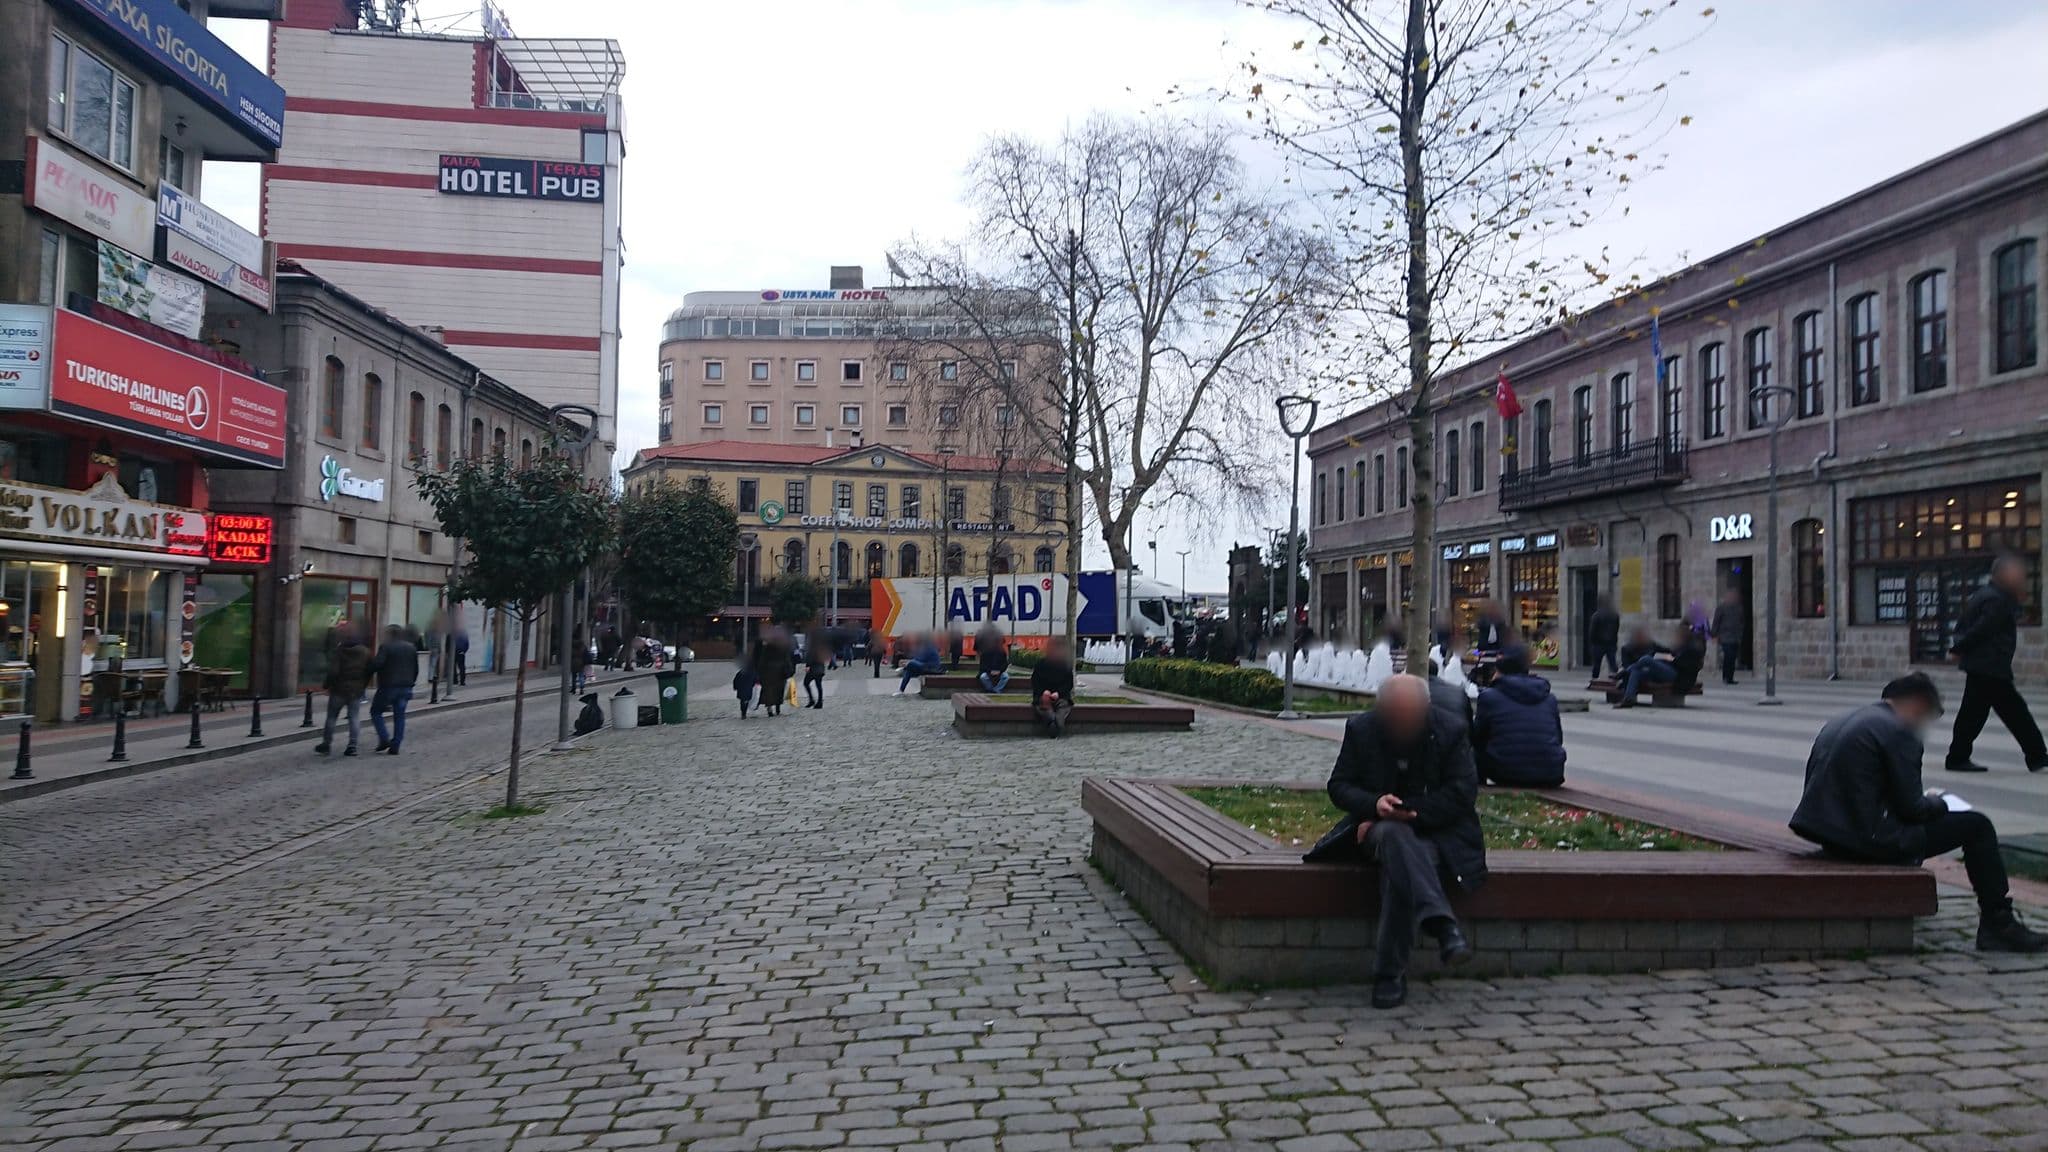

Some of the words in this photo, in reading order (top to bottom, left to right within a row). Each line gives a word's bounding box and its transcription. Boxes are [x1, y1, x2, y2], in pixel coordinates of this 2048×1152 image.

[107, 0, 150, 40] AXA
[155, 24, 229, 97] SİGORTA
[441, 156, 481, 168] KALFA
[543, 163, 601, 177] TERAS
[441, 168, 527, 195] HOTEL
[541, 176, 600, 198] PUB
[782, 291, 807, 299] USTA
[809, 291, 836, 299] PARK
[841, 291, 888, 301] HOTEL
[66, 359, 128, 395] TURKISH
[130, 381, 186, 411] AIRLINES
[40, 496, 159, 541] VOLKAN
[220, 518, 253, 529] 03:00
[256, 520, 265, 530] E
[848, 517, 882, 527] SHOP
[957, 523, 1010, 531] RESTAURNT
[1711, 513, 1752, 542] D&R
[217, 531, 266, 544] KADAR
[222, 546, 262, 560] AÇIK
[948, 585, 1042, 621] AFAD
